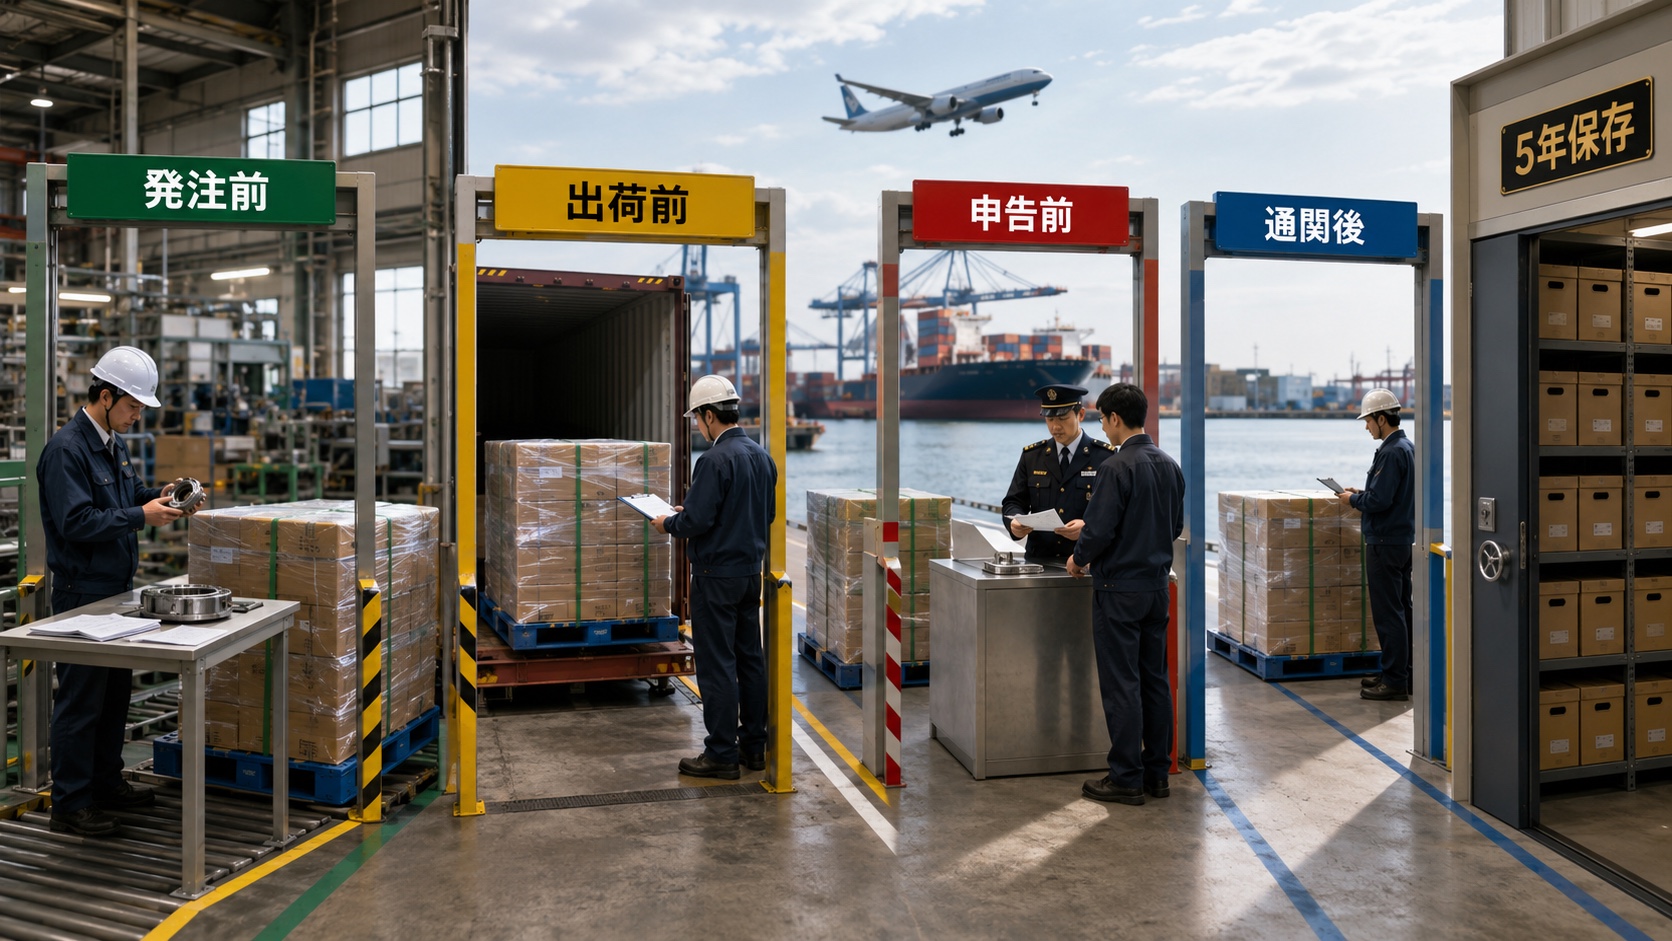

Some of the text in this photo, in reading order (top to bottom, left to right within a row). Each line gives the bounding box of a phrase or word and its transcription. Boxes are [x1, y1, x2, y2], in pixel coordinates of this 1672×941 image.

[1515, 101, 1635, 176] 5年保存
[144, 169, 268, 211] 発注前
[568, 181, 688, 224] 出荷前
[972, 194, 1073, 233] 申告前
[1265, 206, 1366, 246] 通関後
